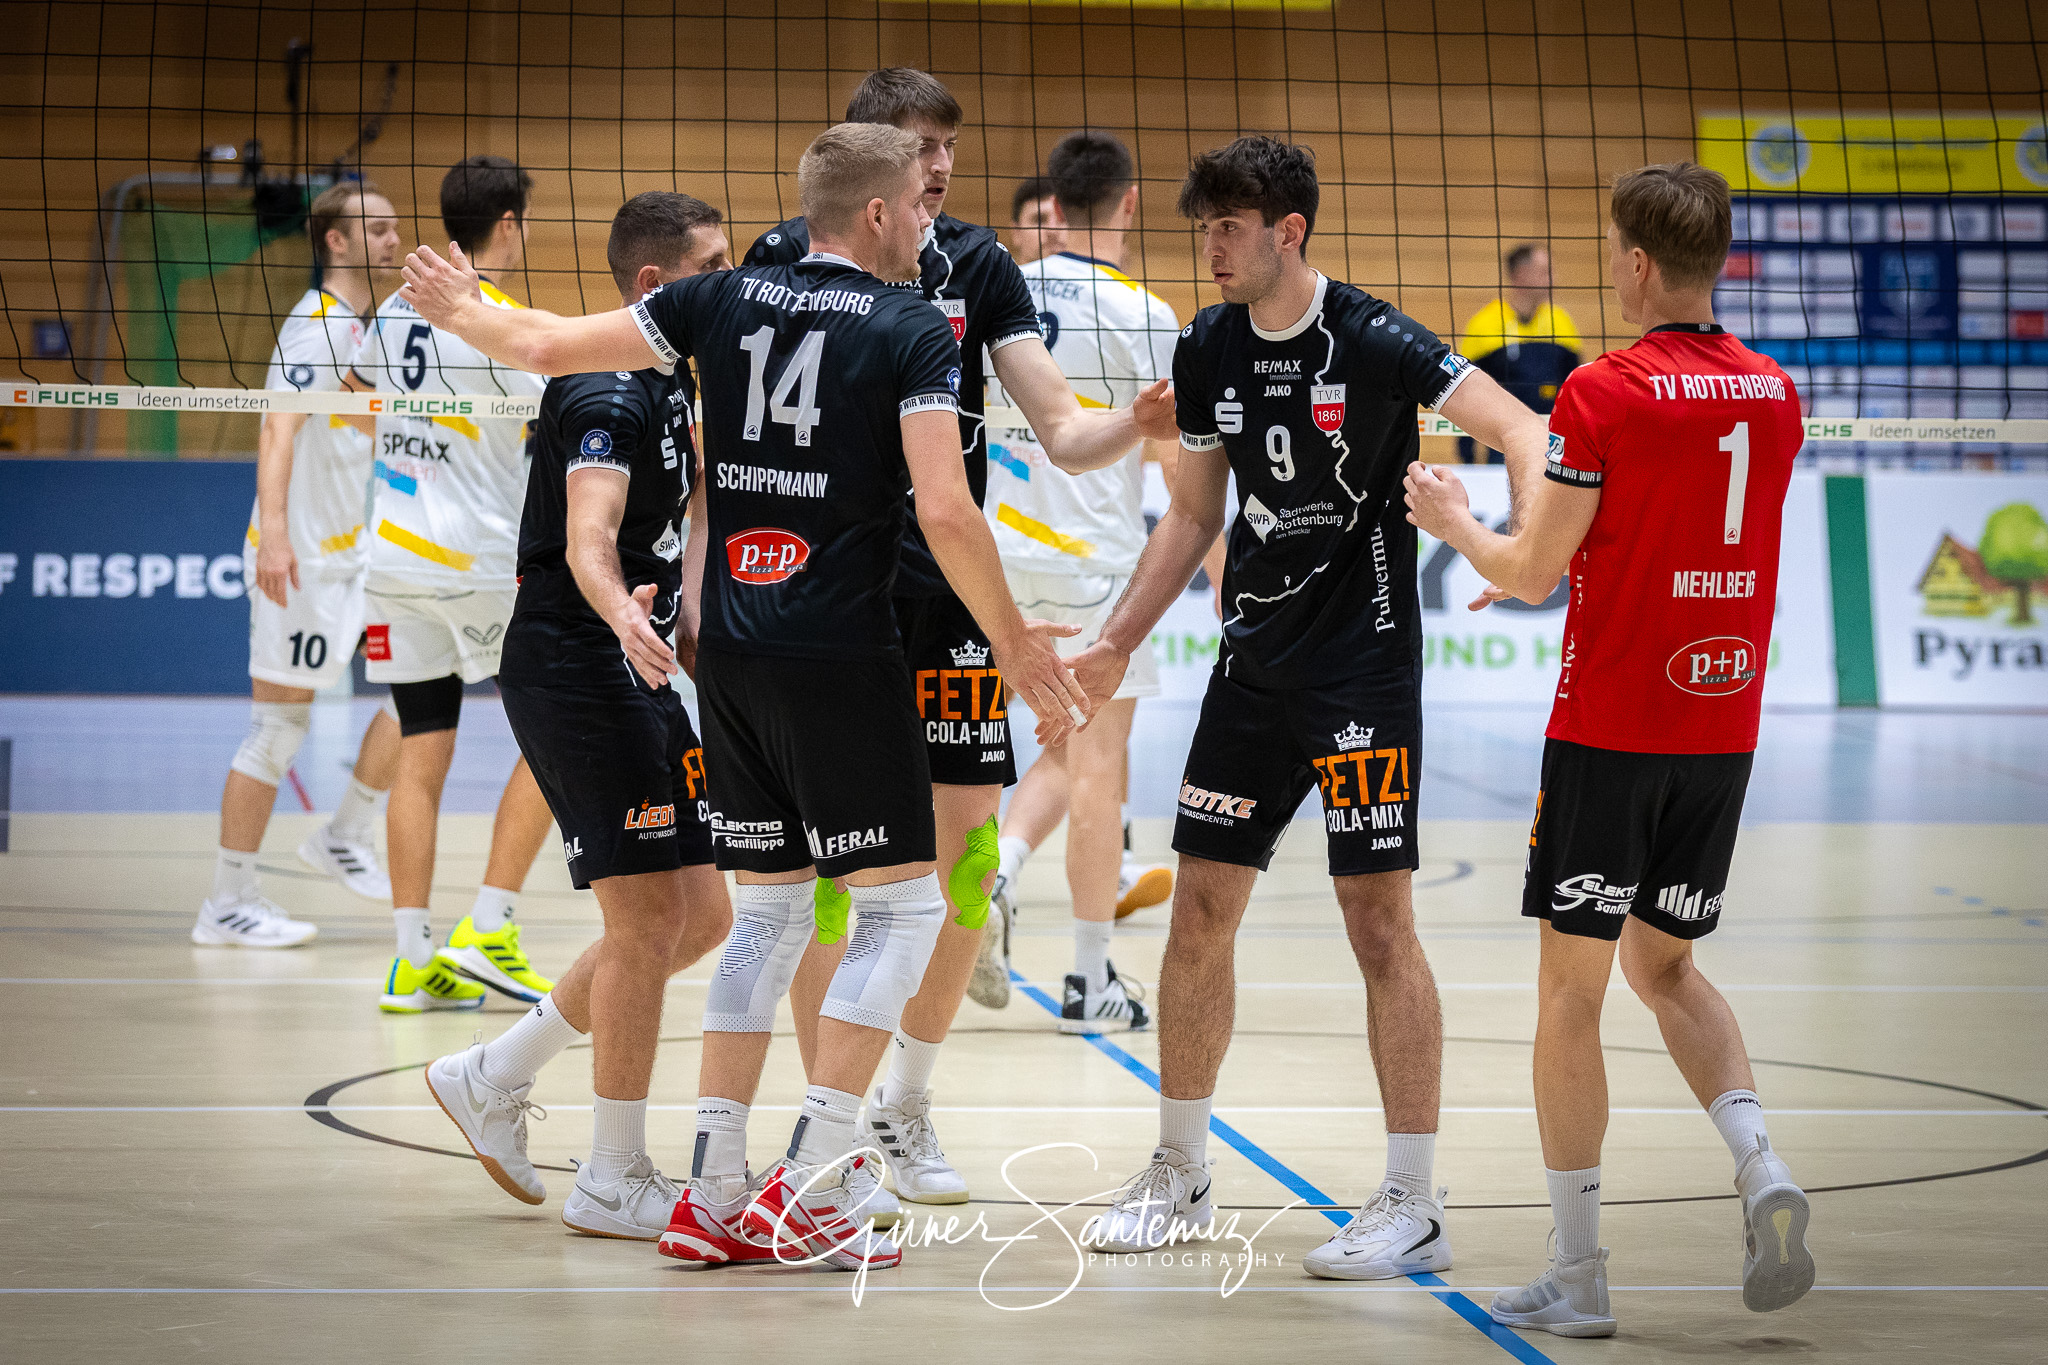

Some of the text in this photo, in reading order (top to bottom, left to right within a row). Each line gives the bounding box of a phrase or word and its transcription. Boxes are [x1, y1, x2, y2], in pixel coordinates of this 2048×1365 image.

[738, 277, 761, 300] TV
[644, 320, 659, 338] WIR
[654, 335, 669, 353] WIR
[402, 323, 431, 391] 5
[1254, 359, 1302, 374] RE/MAX
[1269, 373, 1302, 381] Immobilien
[740, 325, 826, 447] 14
[1264, 384, 1292, 397] JAKO
[1649, 374, 1786, 401] TV ROTTENBURG
[38, 390, 270, 410] FUCHS Ideen umsetzen
[903, 395, 950, 410] WIR WIR WIR
[1316, 389, 1341, 401] TVR
[393, 400, 535, 416] FUCHS Ideen
[1316, 409, 1342, 422] 1861
[1803, 423, 1996, 440] CHS Ideen umsetzen
[1186, 435, 1215, 447] WIR WIR
[1266, 425, 1296, 482] 9
[717, 462, 828, 498] SCHIPPMANN
[1562, 466, 1578, 480] WIR
[1579, 470, 1596, 483] WIR
[1718, 421, 1749, 545] 1
[1247, 512, 1271, 526] SWR
[1275, 513, 1344, 532] Rottenburg
[659, 538, 678, 552] SWR
[737, 543, 798, 572] p+p
[32, 552, 246, 600] RESPEC
[751, 565, 773, 573] izza
[289, 630, 327, 669] 10
[1689, 648, 1748, 684] p+p
[1705, 675, 1728, 684] izza
[926, 720, 1005, 745] COLA-MIX
[980, 750, 1006, 763] JAKO
[1312, 747, 1410, 807] FETZ!
[711, 818, 783, 833] ELEKTRO
[1327, 803, 1404, 833] COLA-MIX
[725, 836, 785, 851] Sanfilippo
[826, 825, 889, 856] FERAL
[1371, 835, 1403, 851] JAKO
[1387, 1186, 1406, 1198] NIKE
